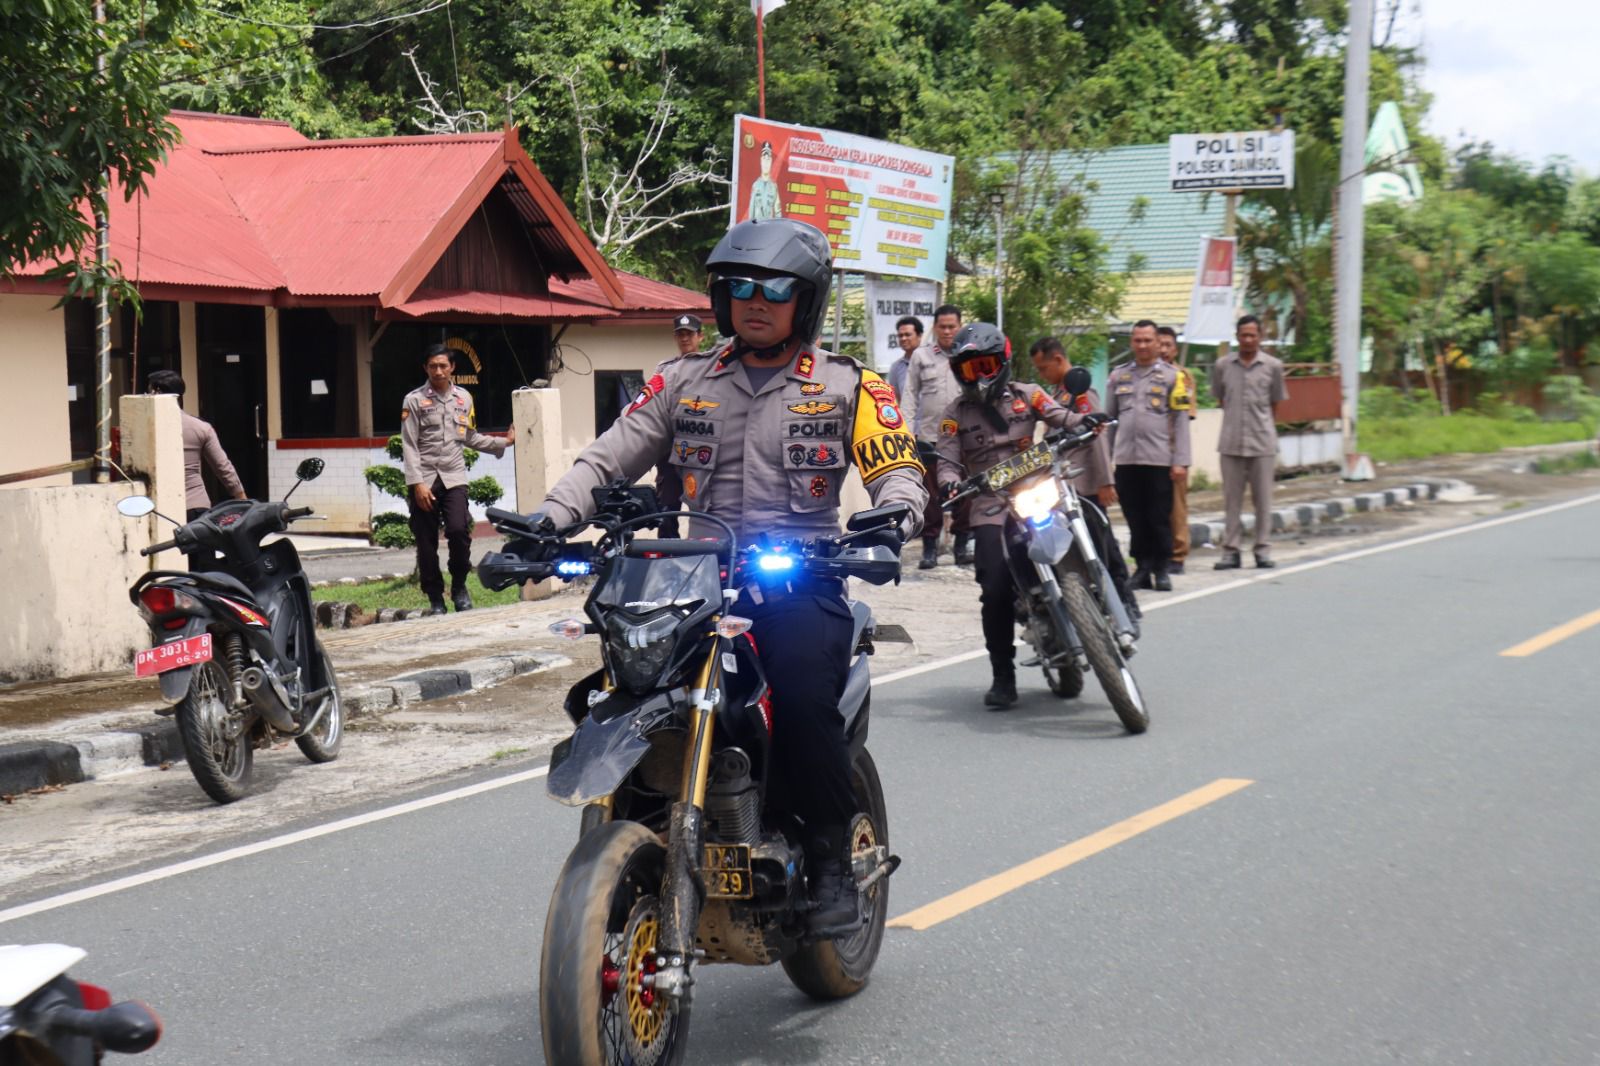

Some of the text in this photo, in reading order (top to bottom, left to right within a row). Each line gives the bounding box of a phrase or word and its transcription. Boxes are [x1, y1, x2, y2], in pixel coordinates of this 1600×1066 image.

[789, 419, 838, 437] POLRI
[138, 651, 154, 665] DN
[201, 636, 210, 648] B
